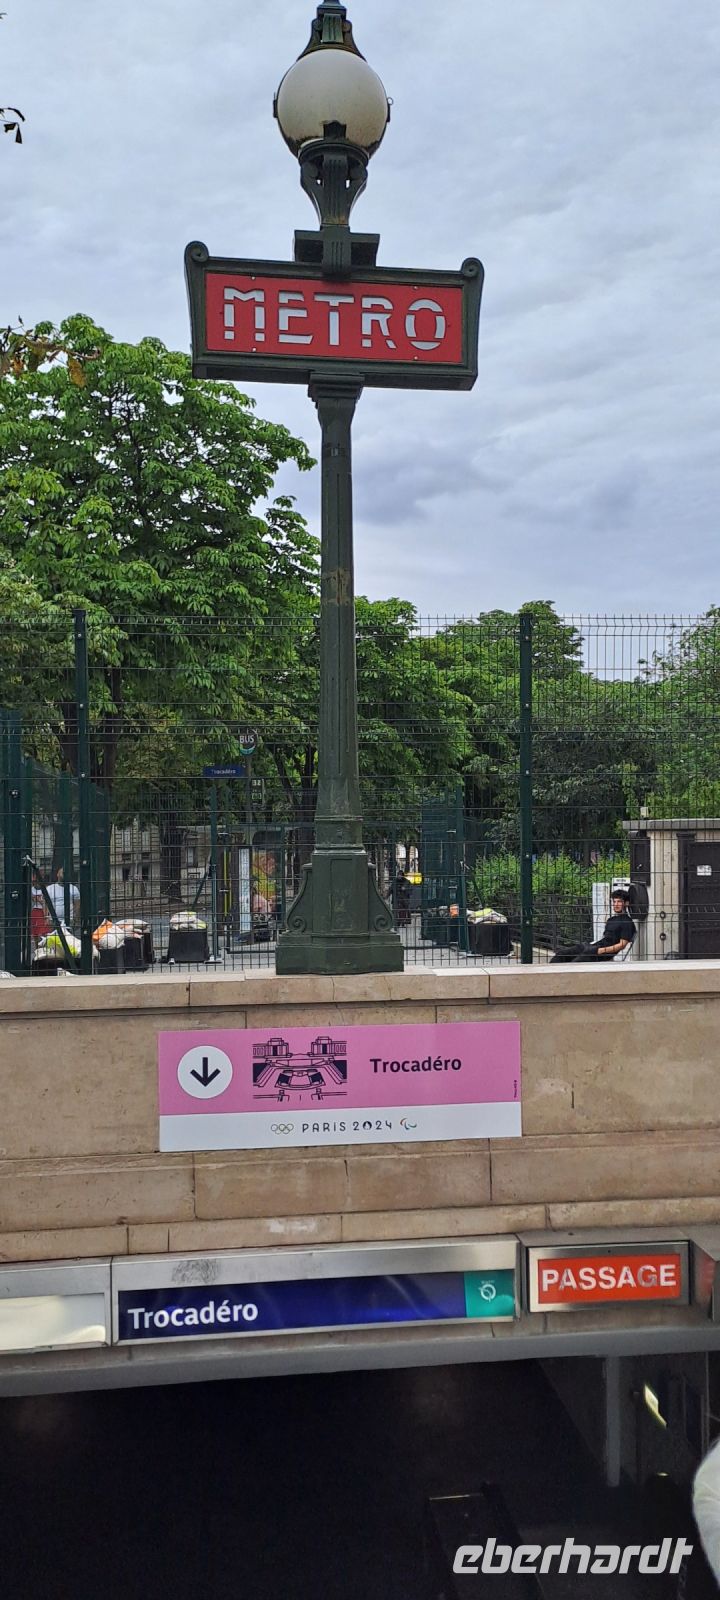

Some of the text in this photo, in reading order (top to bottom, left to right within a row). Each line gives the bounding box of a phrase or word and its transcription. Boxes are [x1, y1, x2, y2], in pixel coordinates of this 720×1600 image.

[223, 286, 446, 351] METRO
[239, 735, 255, 743] BUS
[369, 1056, 462, 1073] Trocadéro
[302, 1120, 392, 1133] PARIS 2024
[542, 1264, 677, 1292] PASSAGE
[127, 1300, 259, 1330] Trocadéro
